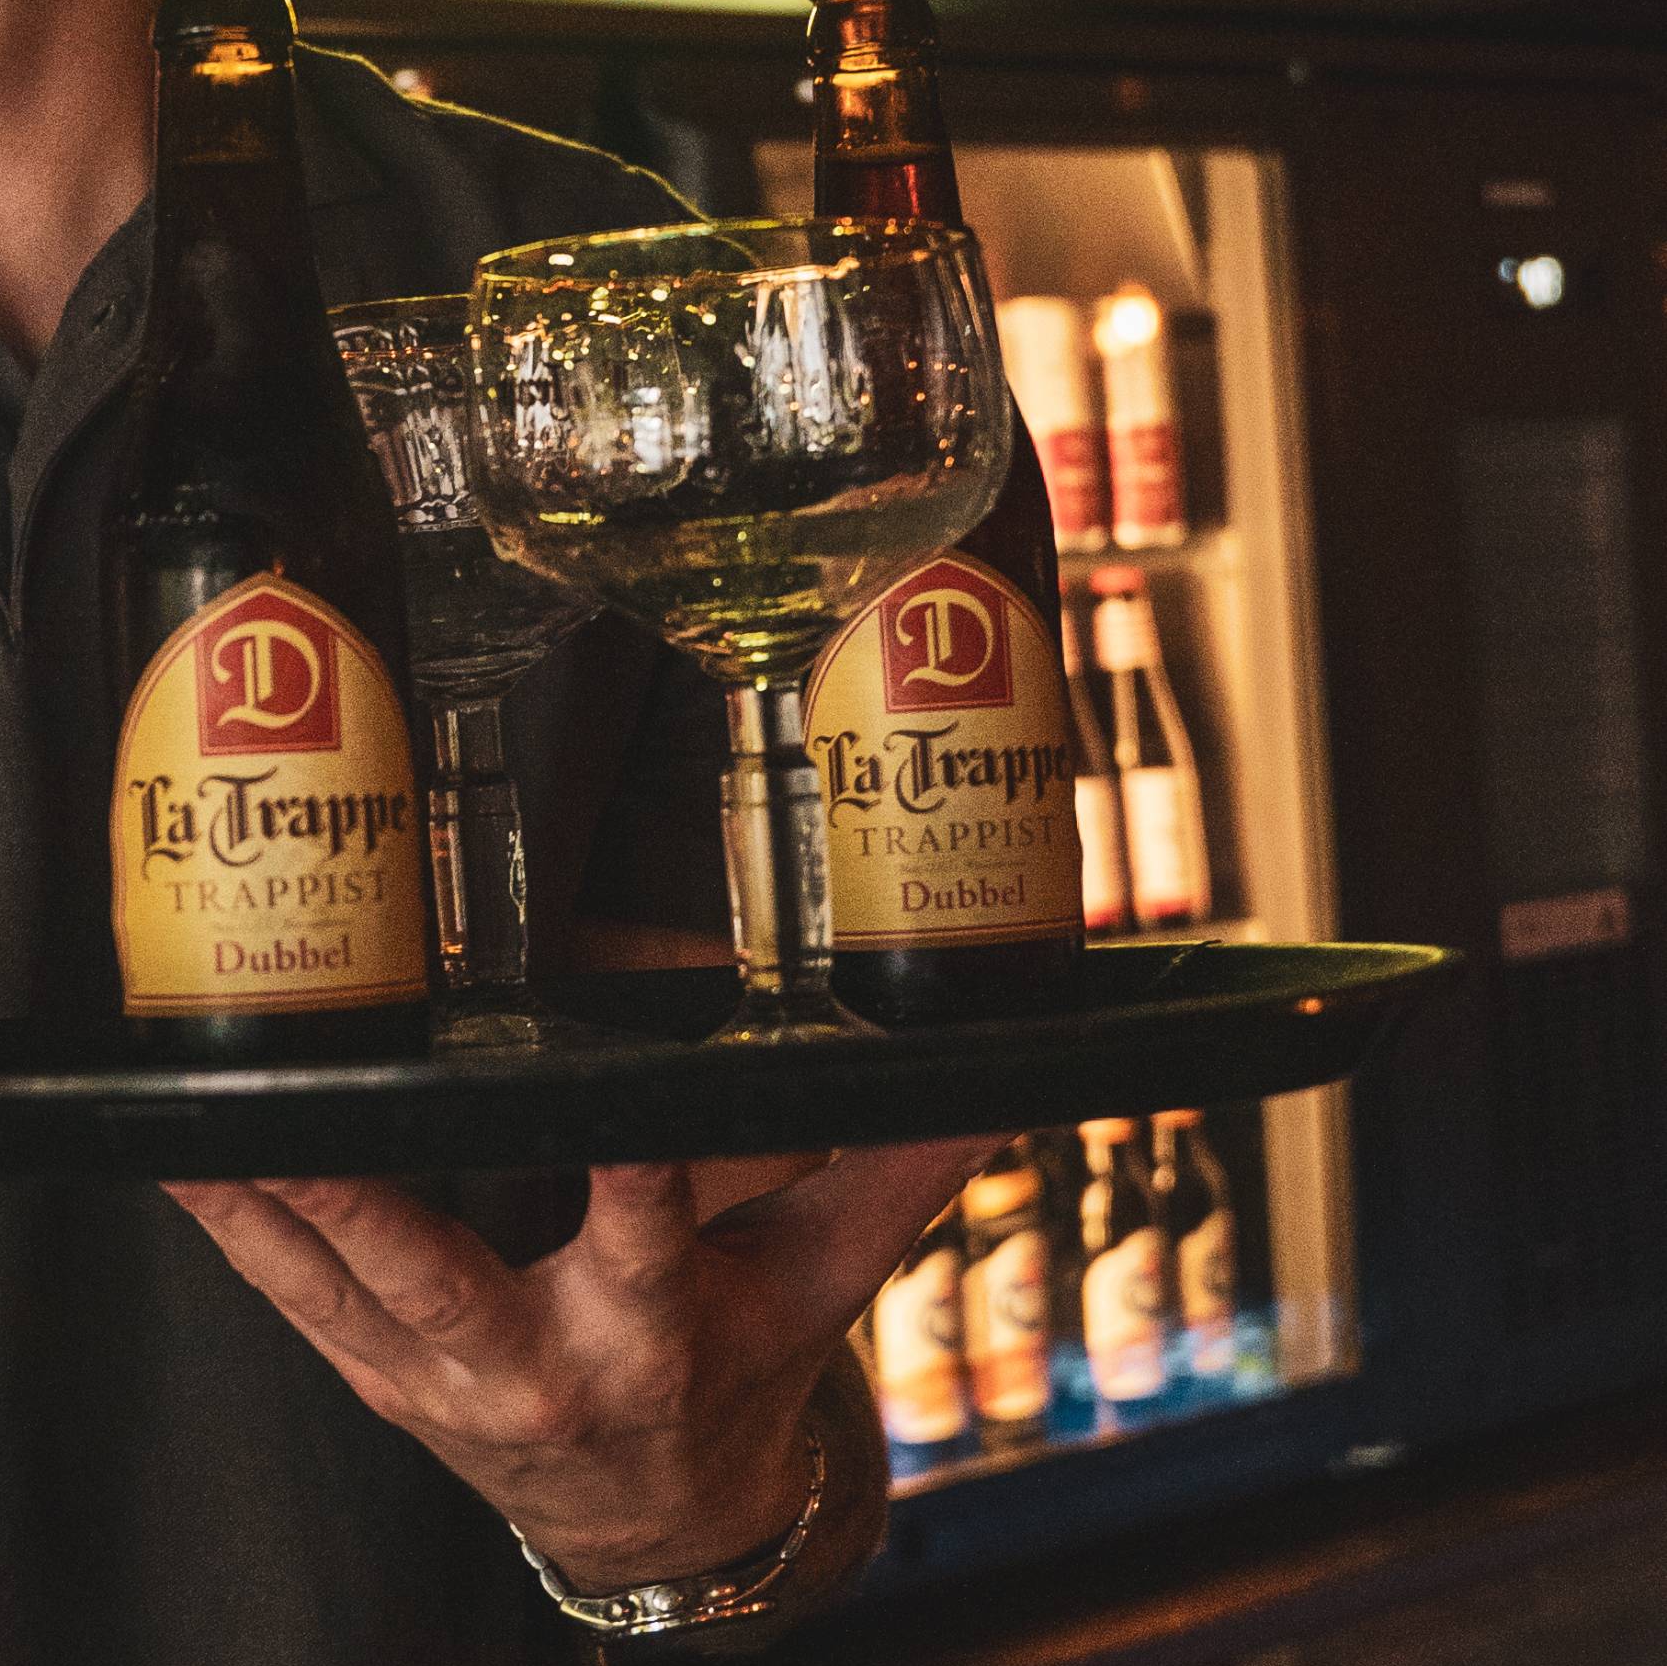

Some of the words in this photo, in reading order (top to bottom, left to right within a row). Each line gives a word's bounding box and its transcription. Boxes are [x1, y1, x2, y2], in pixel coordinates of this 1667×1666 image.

[895, 588, 996, 687] D
[211, 619, 321, 730] D
[813, 730, 885, 829] La
[129, 774, 198, 883] La
[198, 765, 408, 868] Trappe
[855, 815, 1057, 858] TRAPPIST
[164, 869, 387, 915] TRAPPIST
[901, 875, 1026, 913] Dubbel
[214, 934, 351, 976] Dubbel
